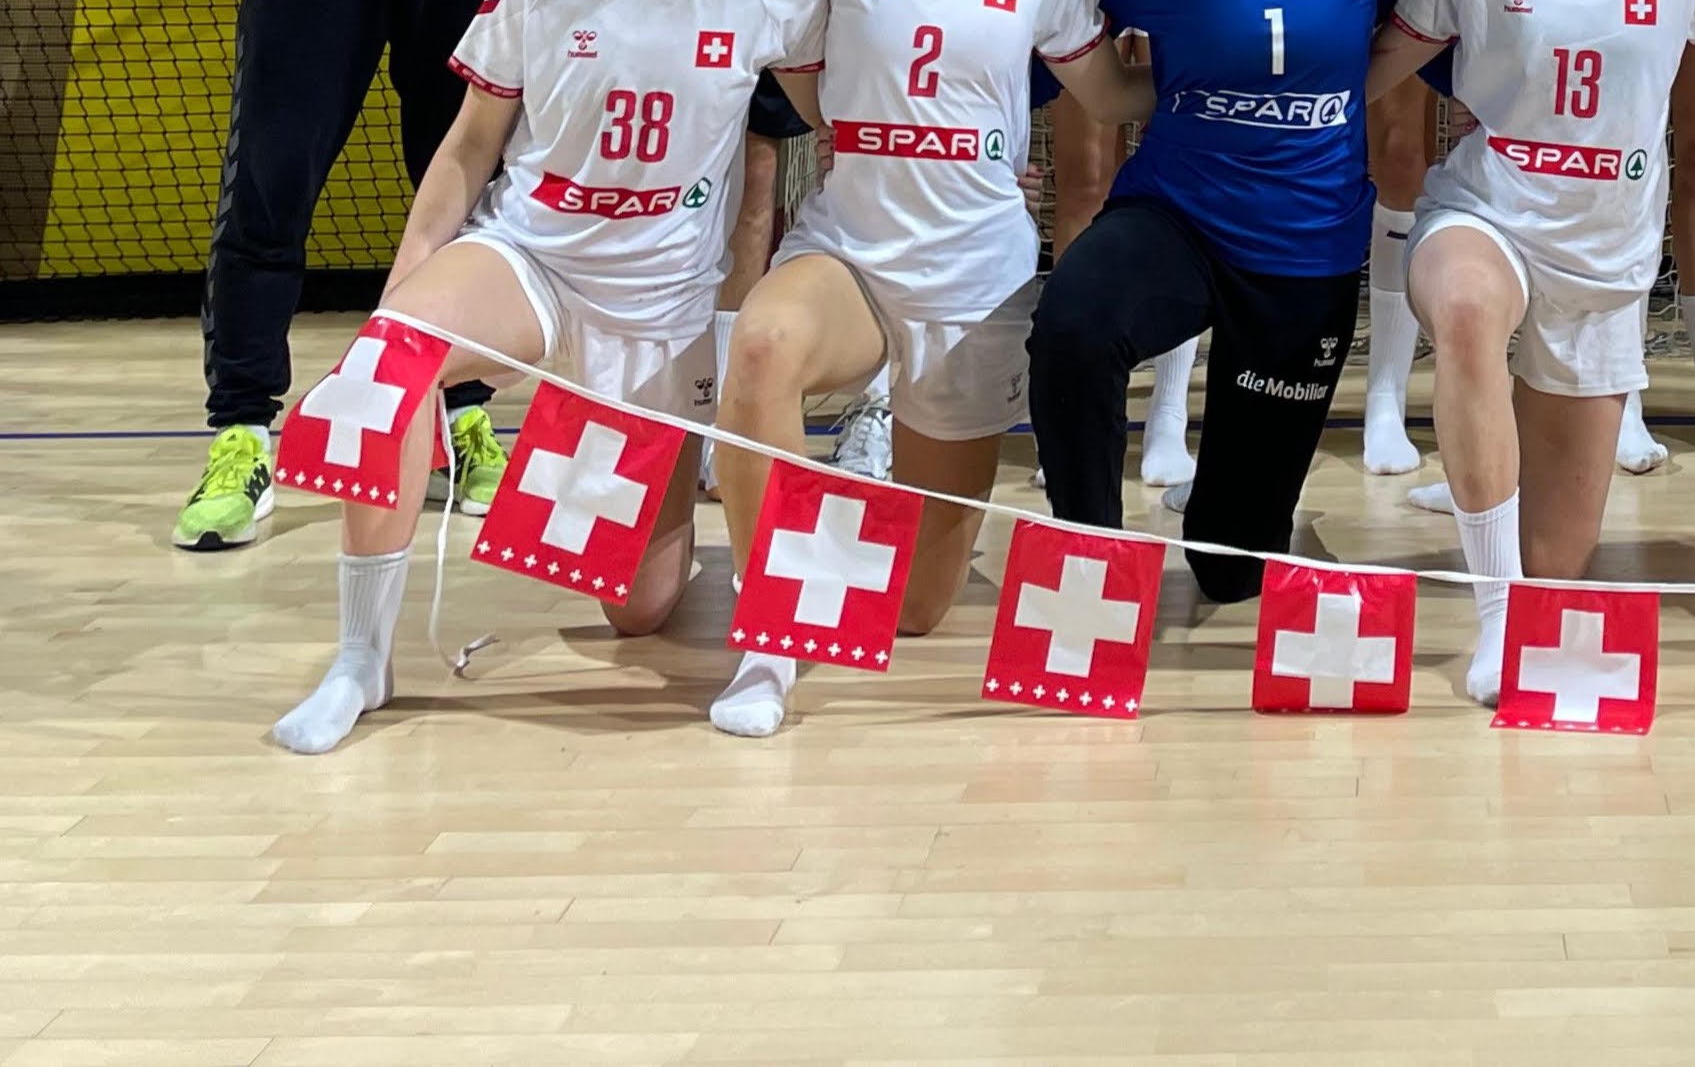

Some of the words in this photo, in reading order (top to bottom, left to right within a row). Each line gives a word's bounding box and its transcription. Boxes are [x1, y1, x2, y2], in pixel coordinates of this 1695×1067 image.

[907, 24, 944, 98] 2
[1264, 8, 1285, 75] 1
[1553, 48, 1603, 119] 13
[600, 89, 674, 163] 38
[1205, 96, 1313, 122] SPAR
[857, 127, 978, 157] SPAR
[1504, 143, 1619, 175] SPAR
[558, 187, 677, 216] SPAR
